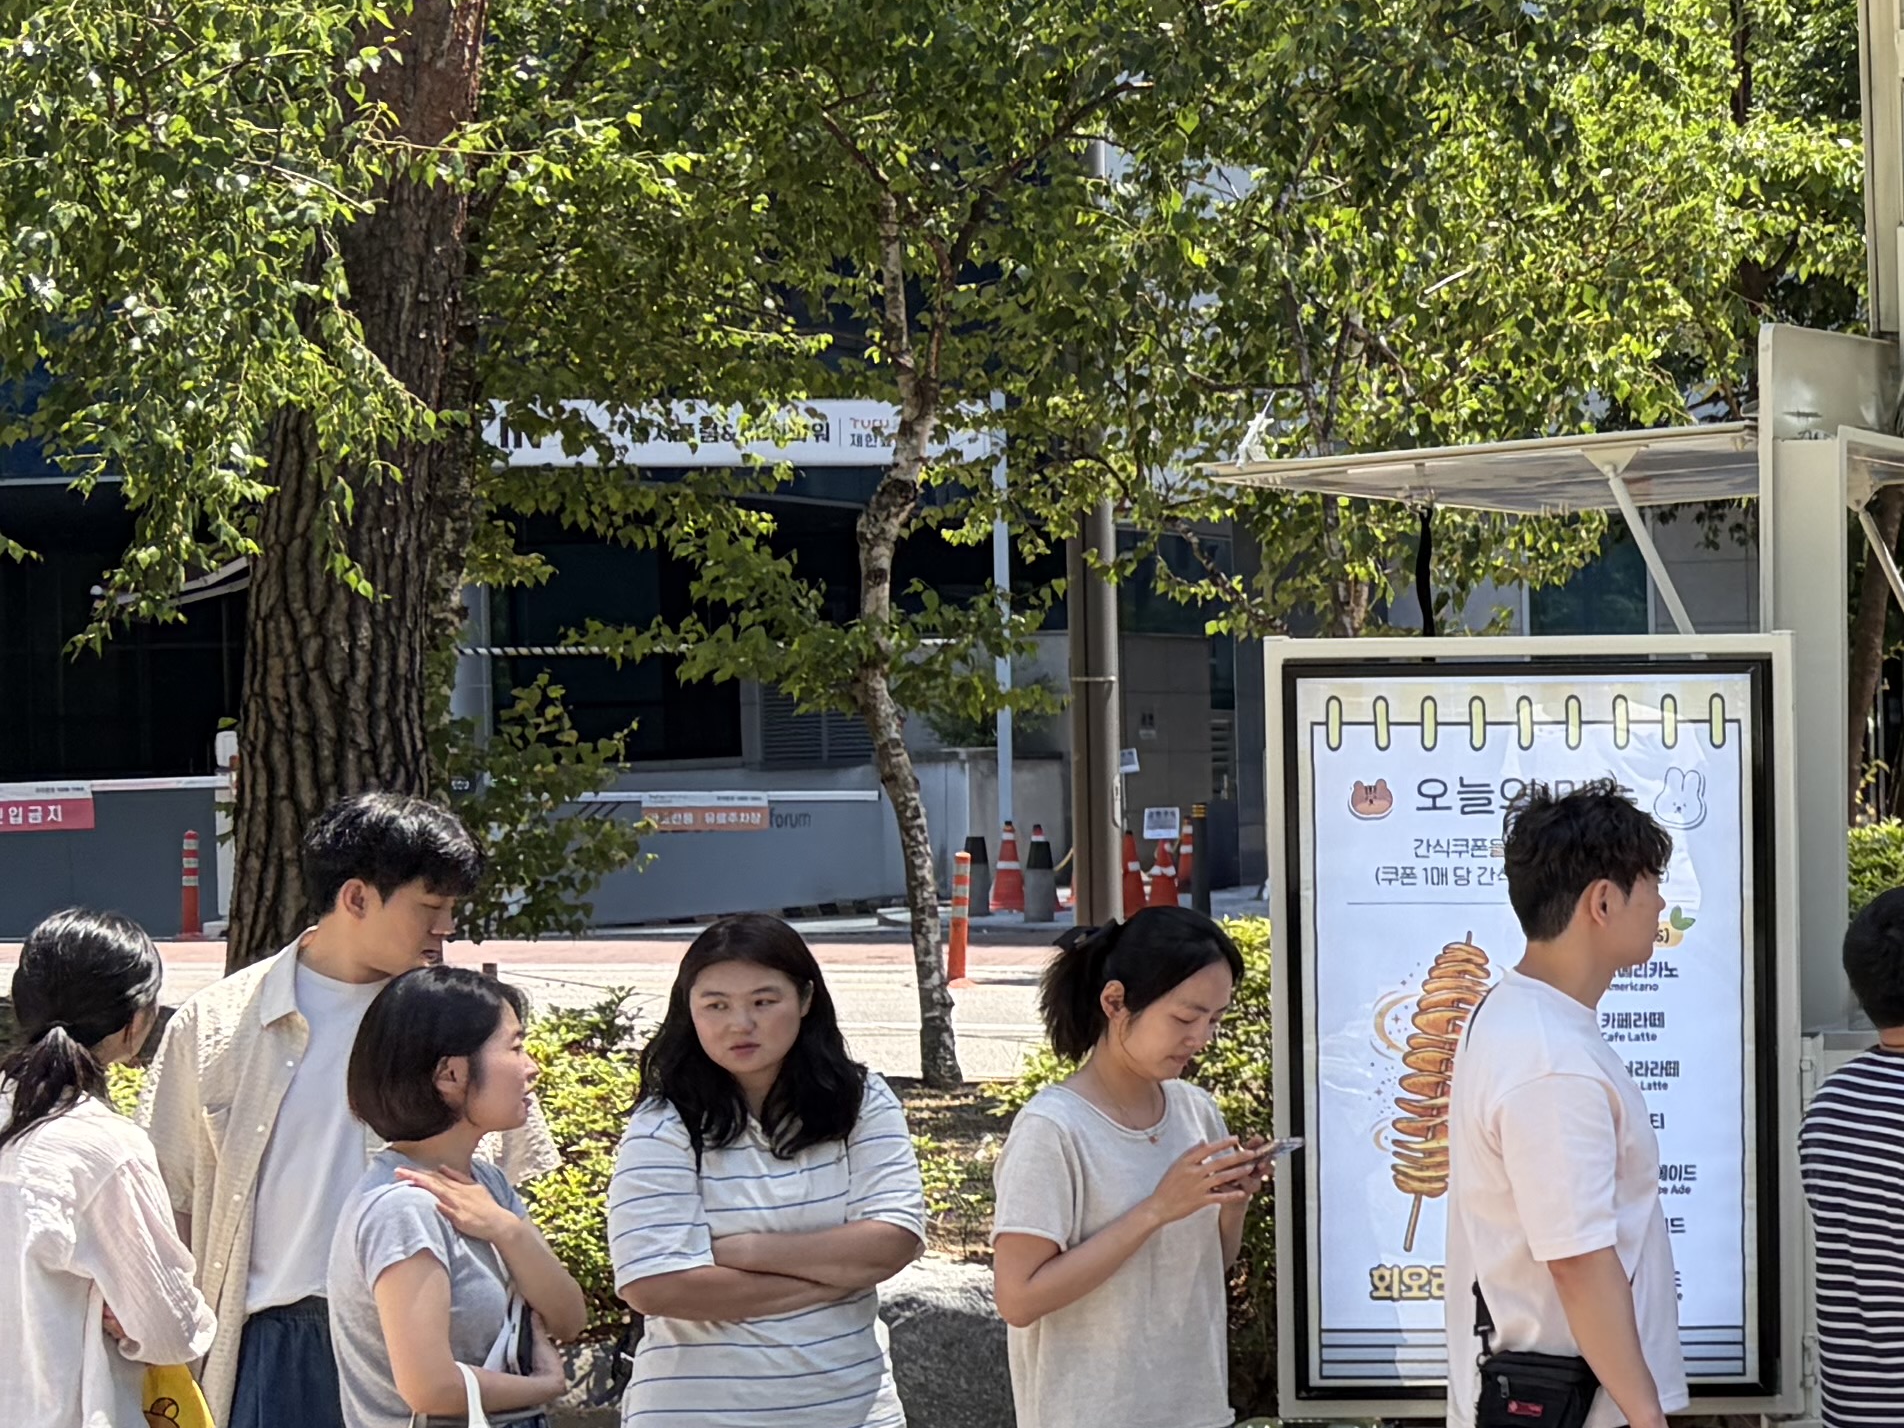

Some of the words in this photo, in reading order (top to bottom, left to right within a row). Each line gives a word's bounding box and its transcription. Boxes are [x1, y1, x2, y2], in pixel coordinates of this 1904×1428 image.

[1375, 866, 1418, 887] (쿠폰
[1424, 866, 1449, 886] 1매
[1453, 866, 1472, 887] 당
[1612, 961, 1680, 980] 메리카노
[1609, 982, 1659, 992] mericano
[1601, 1012, 1665, 1029] 카페라떼
[1628, 1032, 1657, 1042] Latte
[1625, 1060, 1680, 1078] 라라떼
[1641, 1080, 1668, 1091] Latte
[1671, 1184, 1692, 1195] Ade
